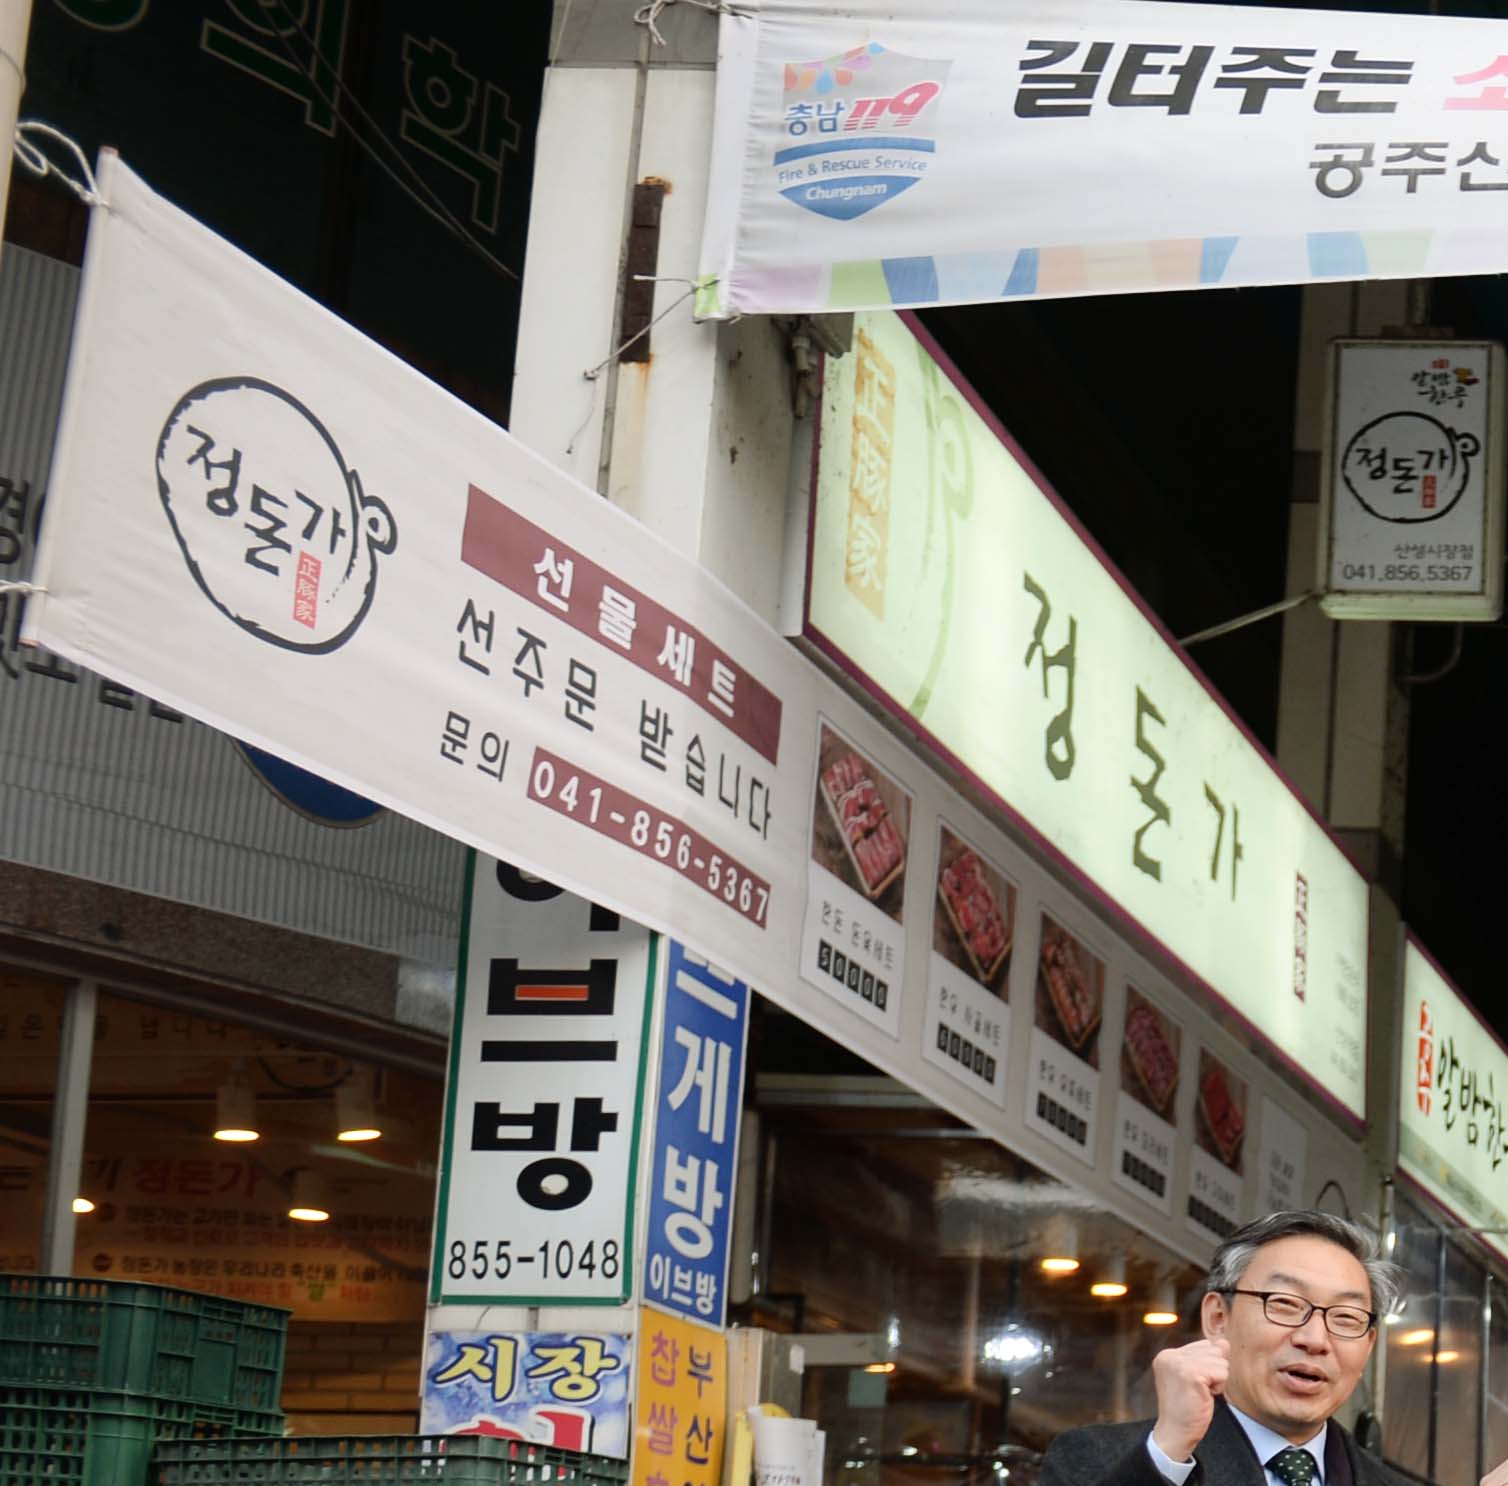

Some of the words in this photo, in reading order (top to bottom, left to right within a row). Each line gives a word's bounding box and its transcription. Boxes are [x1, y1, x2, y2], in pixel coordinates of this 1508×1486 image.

[1014, 37, 1415, 120] 길터주는
[778, 165, 803, 183] Fire
[808, 163, 818, 177] &
[822, 158, 870, 174] Rescue
[875, 155, 928, 171] Service
[805, 183, 887, 201] Chungnam
[186, 424, 347, 577] 정돈가
[1355, 449, 1449, 494] 정돈가
[1343, 564, 1473, 582] 041.856.5367
[533, 547, 737, 718] 선물세트
[456, 597, 598, 732] 선주문
[639, 699, 773, 840] 받습니다
[1024, 570, 1243, 901] 정돈가
[440, 710, 510, 782] 문의
[533, 761, 768, 920] 041-856-5367
[449, 1239, 619, 1281] 855-1048
[649, 1251, 717, 1317] 이브방
[435, 1336, 621, 1402] 시장
